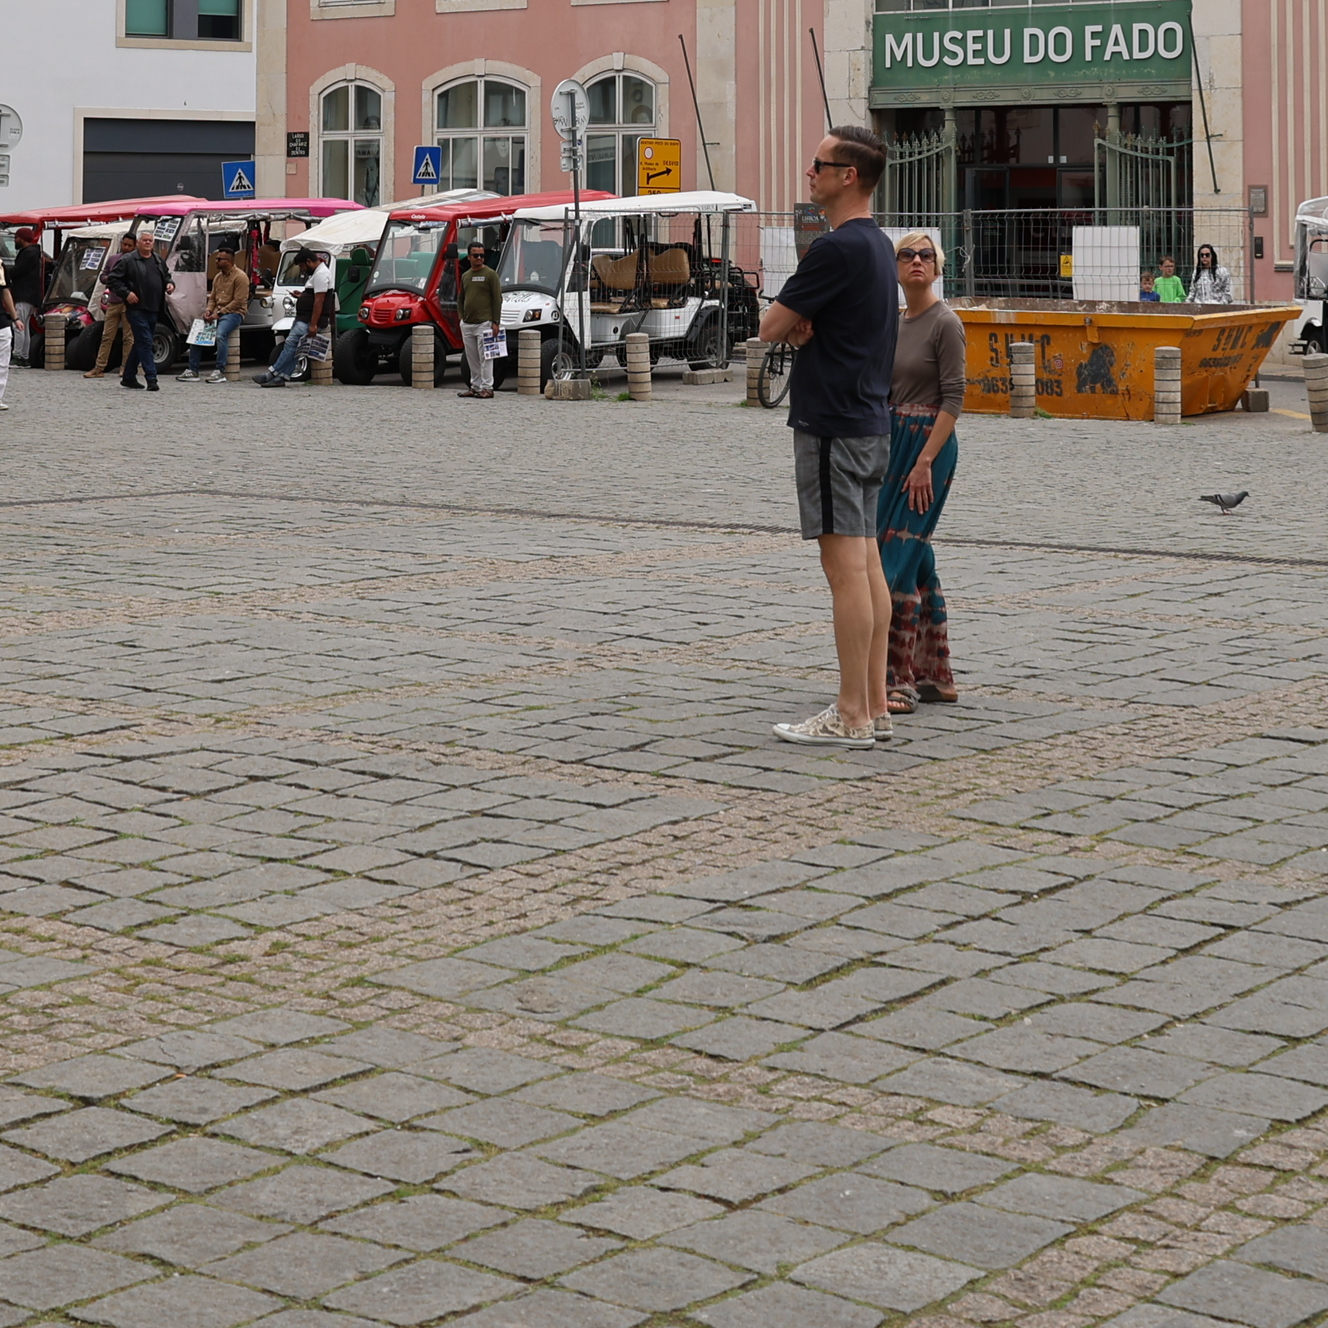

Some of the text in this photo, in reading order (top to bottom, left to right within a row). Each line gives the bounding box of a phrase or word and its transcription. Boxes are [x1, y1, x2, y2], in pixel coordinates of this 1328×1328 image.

[884, 21, 1184, 68] MUSEU DO FADO
